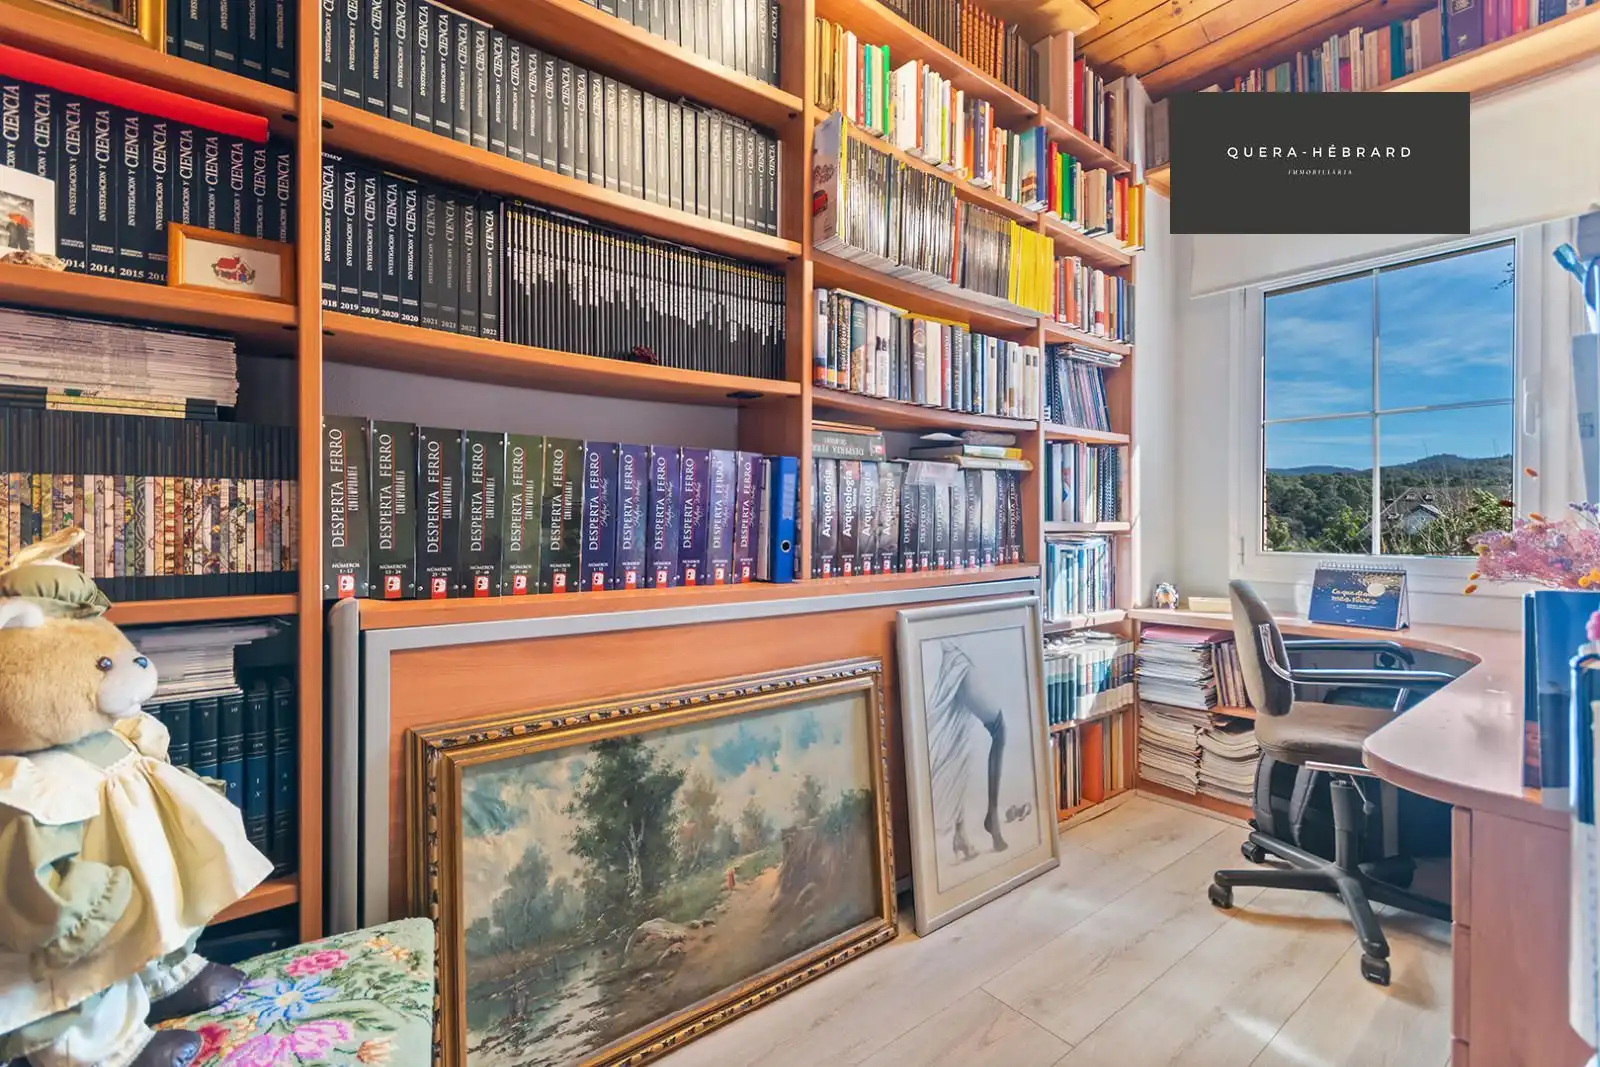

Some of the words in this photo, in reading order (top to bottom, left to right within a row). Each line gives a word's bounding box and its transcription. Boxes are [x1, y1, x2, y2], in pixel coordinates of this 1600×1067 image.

[371, 0, 382, 30] CIENC
[418, 6, 428, 48] CIENCIA
[438, 15, 448, 56] CIENCIA
[458, 23, 468, 64] CIENCIA
[476, 31, 485, 71] CIENCIA
[494, 37, 503, 78] CIENCIA
[511, 45, 520, 86] CIENCIA
[528, 54, 537, 93] CIENCIA
[545, 61, 554, 100] CIENCIA
[562, 67, 570, 106] CIENCIA
[3, 85, 20, 141] CIENCIA
[577, 74, 585, 112] CIENCIA
[34, 93, 51, 148] CIENCIA
[66, 102, 80, 155] CIENCIA
[95, 110, 110, 162] CIENCIA
[125, 116, 140, 168] CIENCIA
[152, 123, 167, 174] CIENCIA
[179, 129, 193, 179] CIENCIA
[205, 136, 218, 185] CIENCIA
[230, 143, 244, 191] CIENCIA
[254, 149, 266, 197] CIENCIA
[277, 154, 290, 201] CIENCIA
[323, 165, 334, 210] CIENCIA
[344, 171, 356, 216] CIENCIA
[364, 177, 376, 222] CIENCIA
[386, 184, 397, 227] CIENCIA
[406, 189, 416, 232] CIENCIA
[427, 194, 435, 237] CIENCIA
[446, 200, 455, 241] CIENCIA
[465, 205, 474, 246] CIENCIA
[485, 210, 494, 250] CIENCIA
[90, 262, 115, 274] 2014
[120, 268, 144, 279] 2015
[147, 272, 168, 281] 201
[320, 300, 337, 308] 018
[340, 303, 359, 311] 2019
[361, 307, 380, 315] 2019
[381, 309, 400, 318] 2020
[401, 314, 419, 322] 2020
[422, 317, 438, 325] 2021
[482, 327, 497, 336] 2022
[329, 428, 343, 472] FERRO
[379, 434, 392, 477] FERRO
[428, 441, 440, 483] FERRO
[472, 443, 484, 484] FERRO
[512, 447, 524, 486] FERRO
[553, 449, 564, 487] FERRO
[589, 452, 600, 489] FERRO
[624, 454, 633, 490] FERRO
[657, 457, 666, 492] FERRO
[684, 458, 695, 492] FERRO
[331, 480, 345, 547] DESPERTA
[380, 485, 392, 550] DESPERTA
[427, 491, 439, 553] DESPERTA
[470, 491, 482, 552] DESPERTA
[511, 493, 522, 552] DESPERTA
[550, 494, 562, 551] DESPERTA
[589, 496, 599, 550] DESPERTA
[622, 496, 633, 550] DESPERTA
[654, 498, 665, 550] DESPERTA
[683, 498, 693, 548] DESPERTA
[740, 500, 750, 548] DESPERTA
